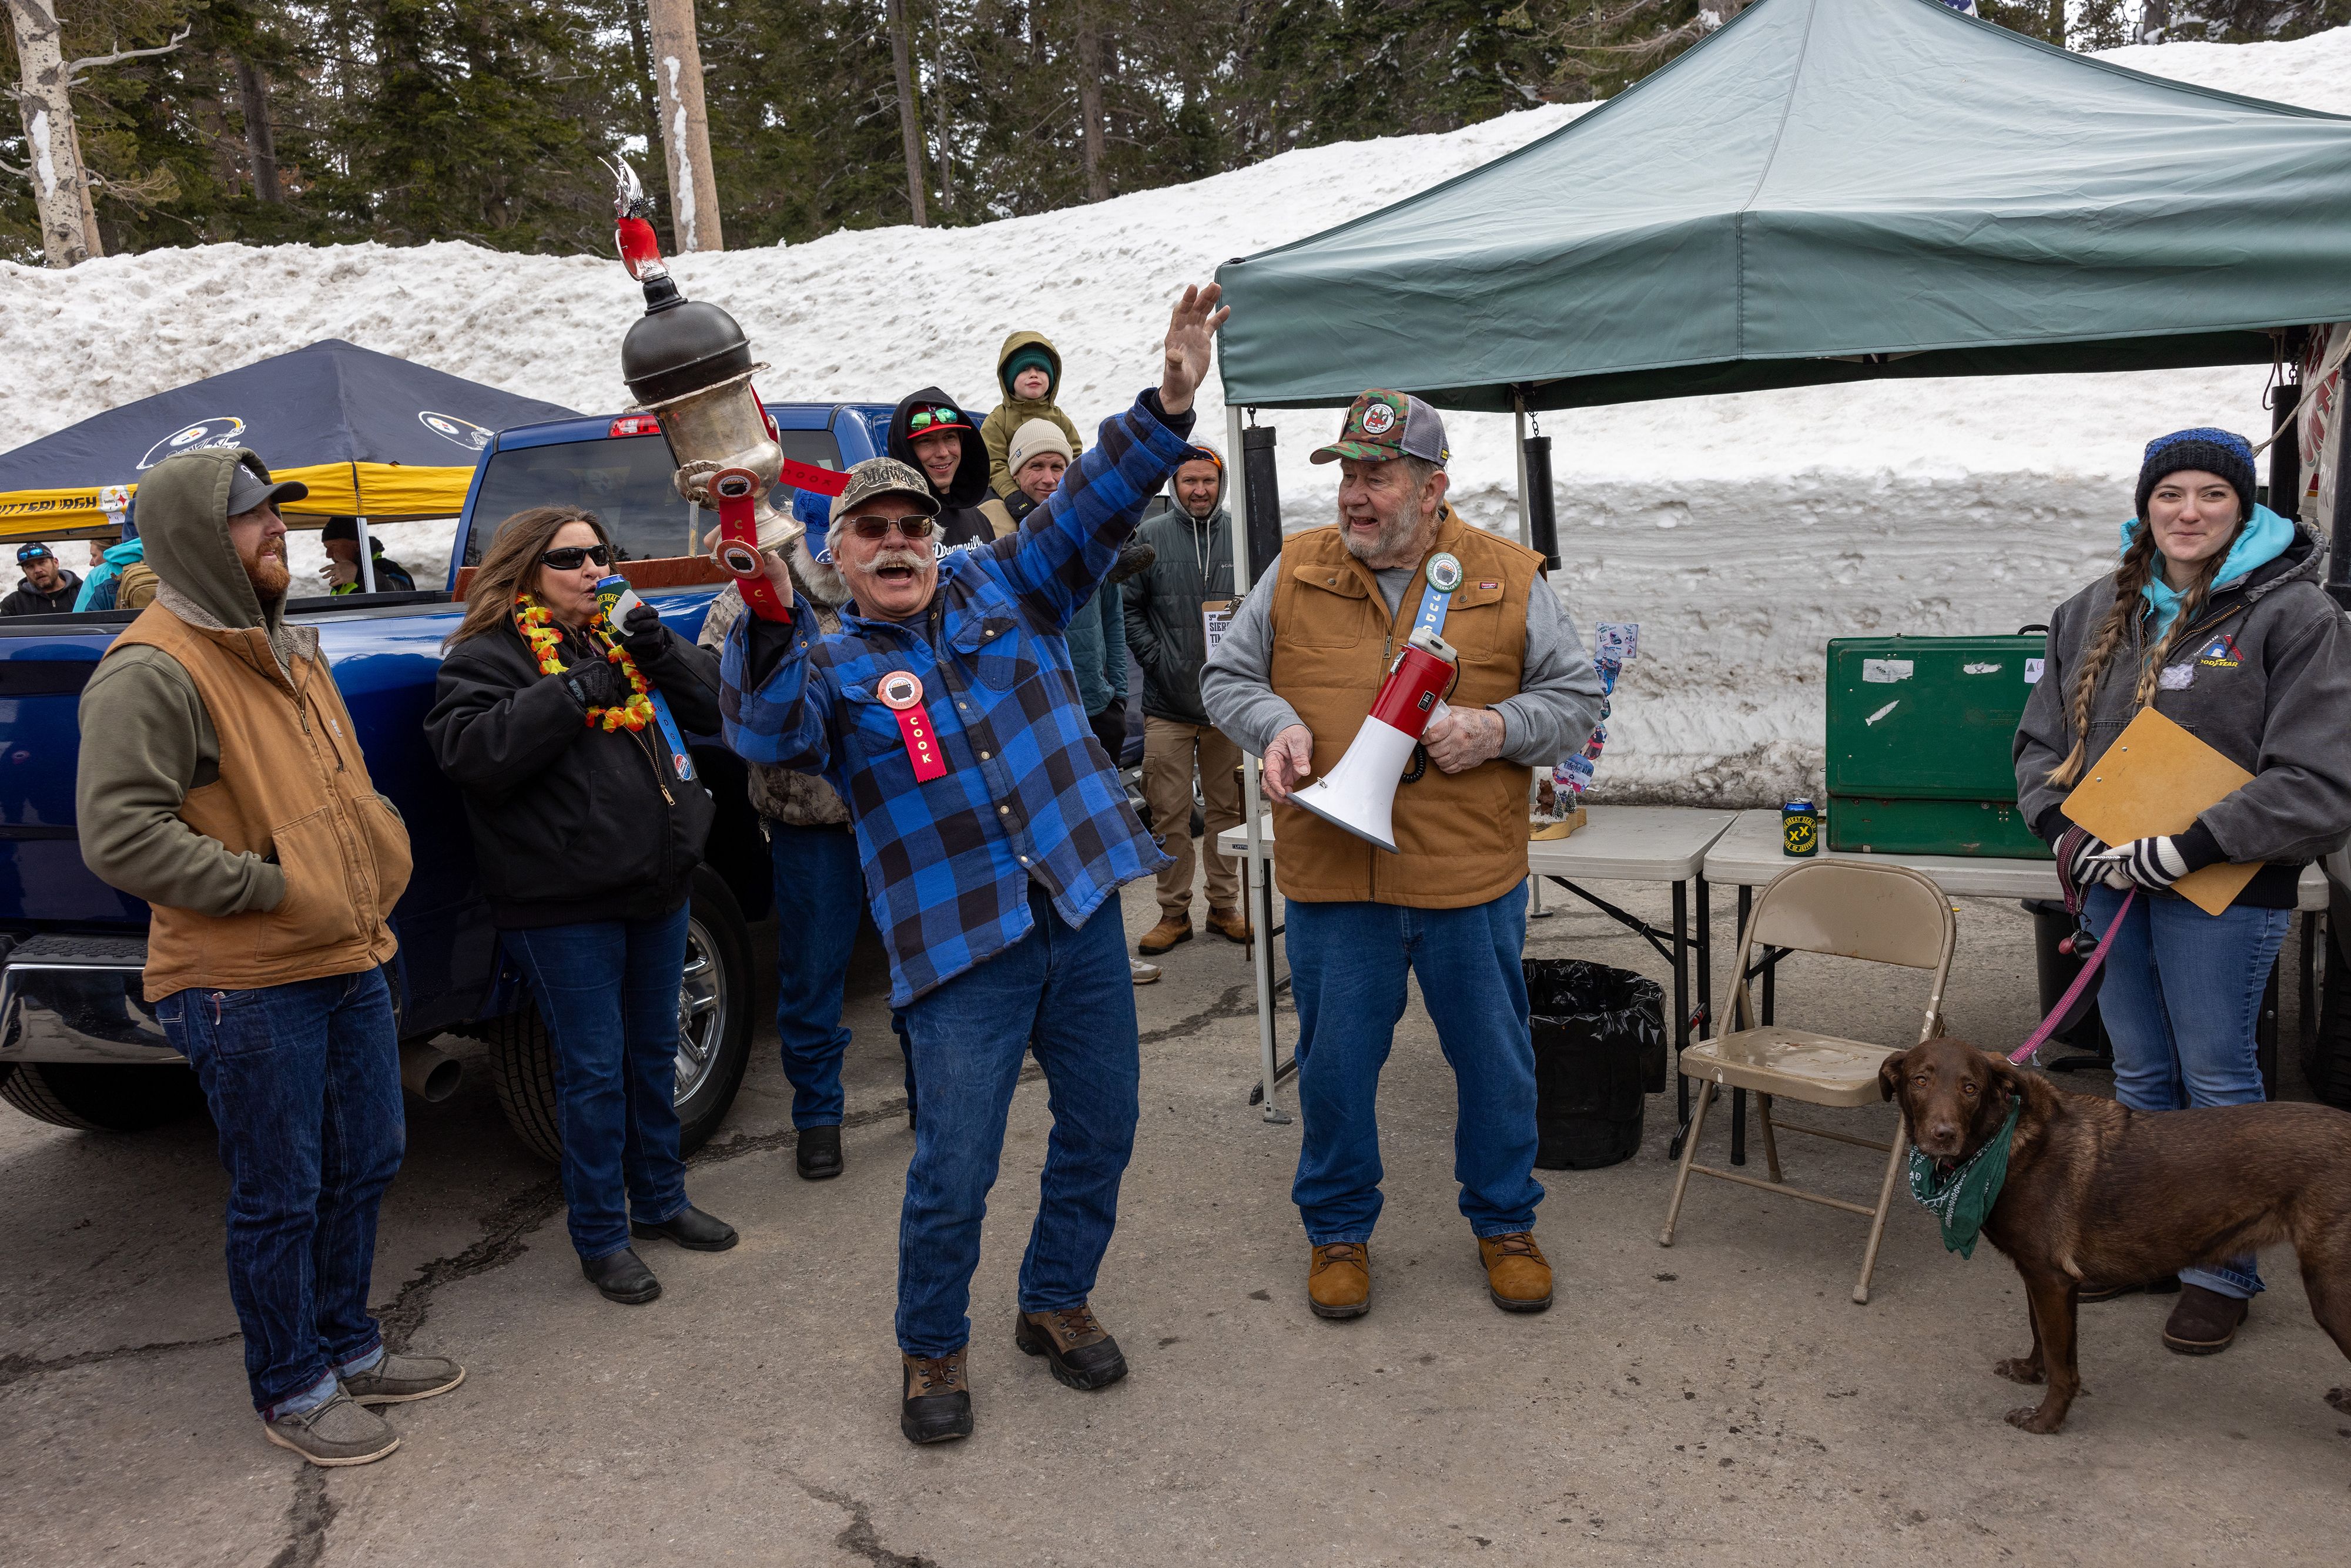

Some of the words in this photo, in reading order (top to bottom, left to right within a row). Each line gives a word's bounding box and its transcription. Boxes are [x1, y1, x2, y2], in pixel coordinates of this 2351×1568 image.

[1451, 557, 1460, 569] YUBA
[1429, 573, 1438, 586] CHILI
[1437, 582, 1458, 591] COOK-OFF
[910, 716, 932, 763] COOK
[1786, 817, 1800, 825] GREAT
[1802, 817, 1813, 825] SEAL
[1799, 833, 1817, 851] JEFFERSON
